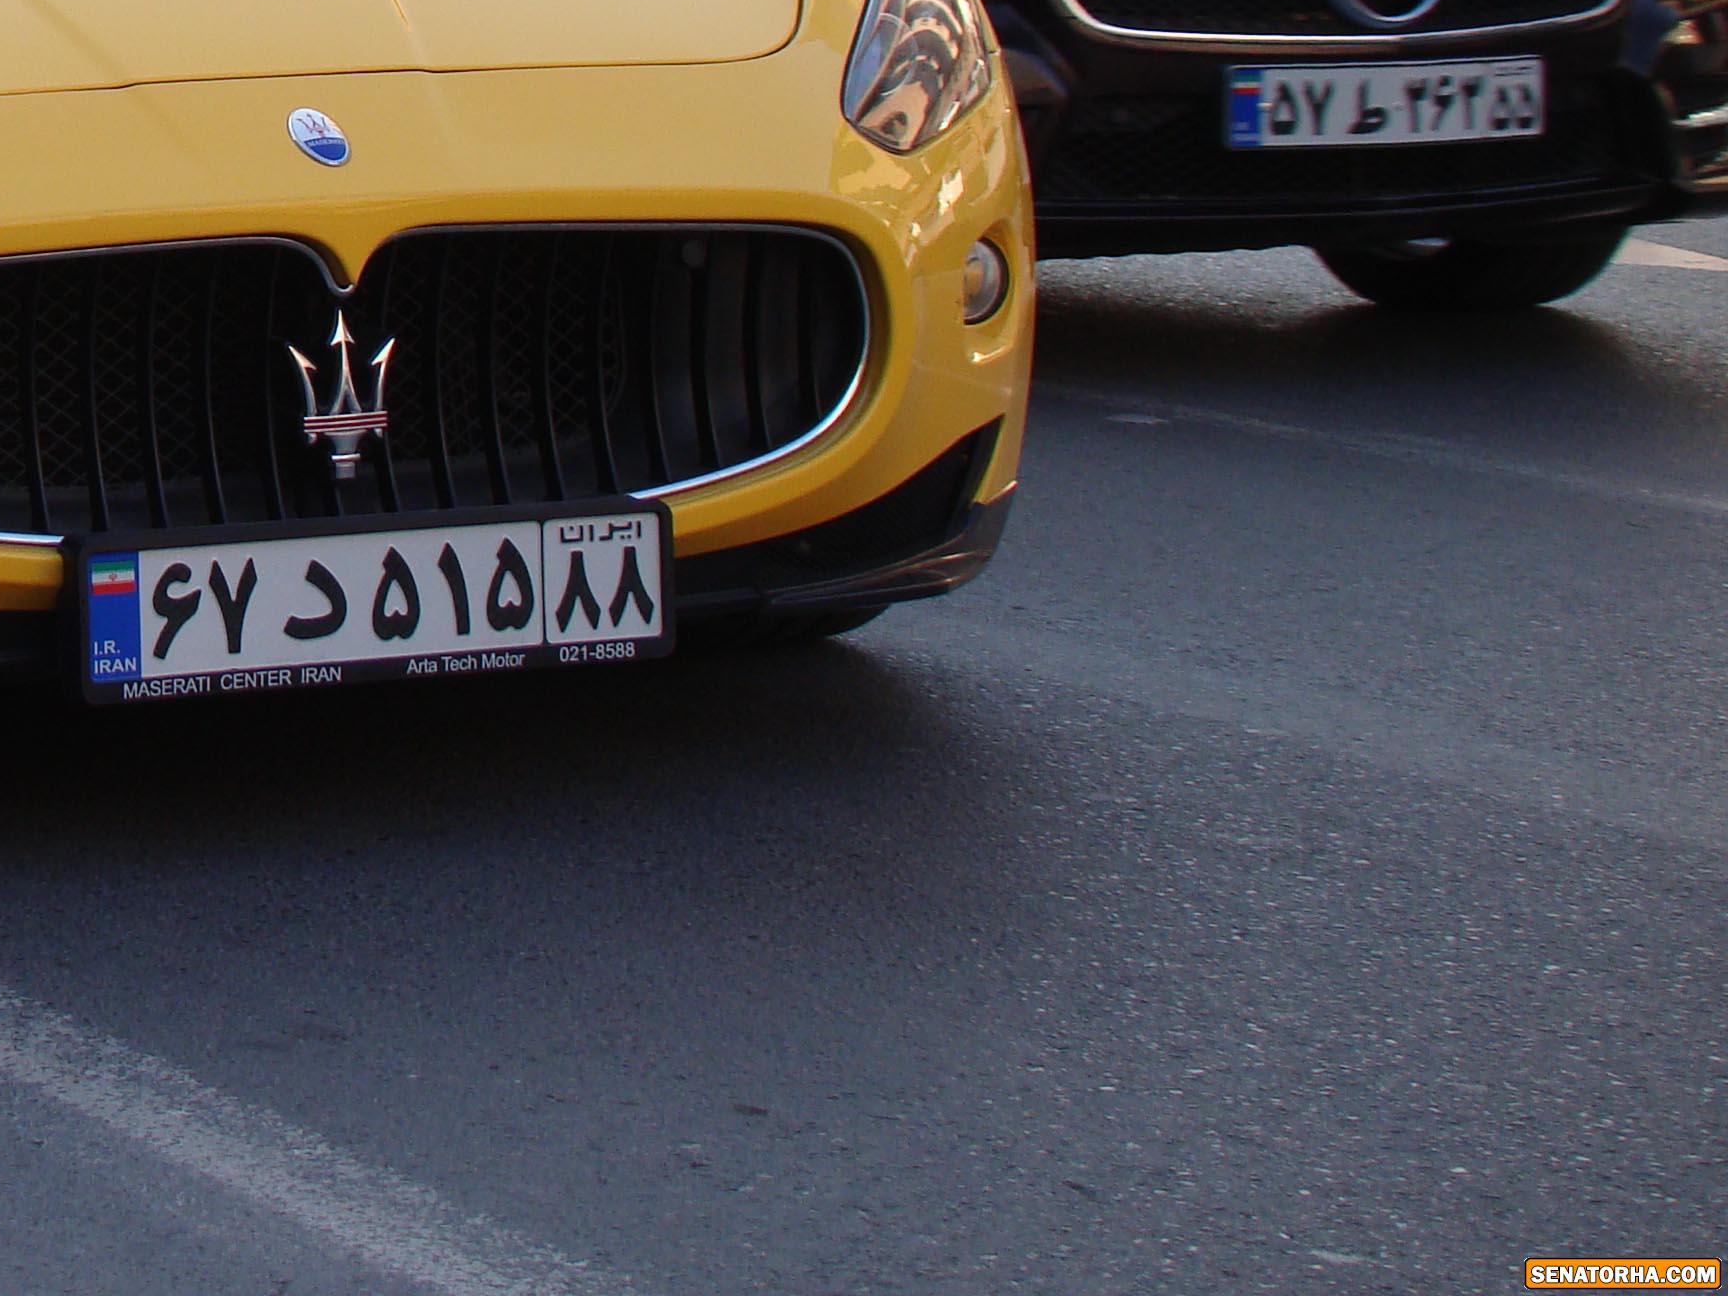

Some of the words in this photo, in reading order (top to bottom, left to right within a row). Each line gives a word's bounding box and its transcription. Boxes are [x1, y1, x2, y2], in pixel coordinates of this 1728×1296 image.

[559, 519, 642, 543] ایران
[555, 545, 654, 633] ۸۸
[94, 640, 120, 655] I.R.
[559, 642, 636, 662] 021-8588
[94, 656, 137, 674] IRAN
[407, 656, 438, 674] Arta
[441, 654, 478, 672] Tech
[482, 651, 525, 670] Motor
[123, 677, 211, 699] MASERATI
[220, 669, 292, 691] CENTER
[300, 666, 342, 685] IRAN
